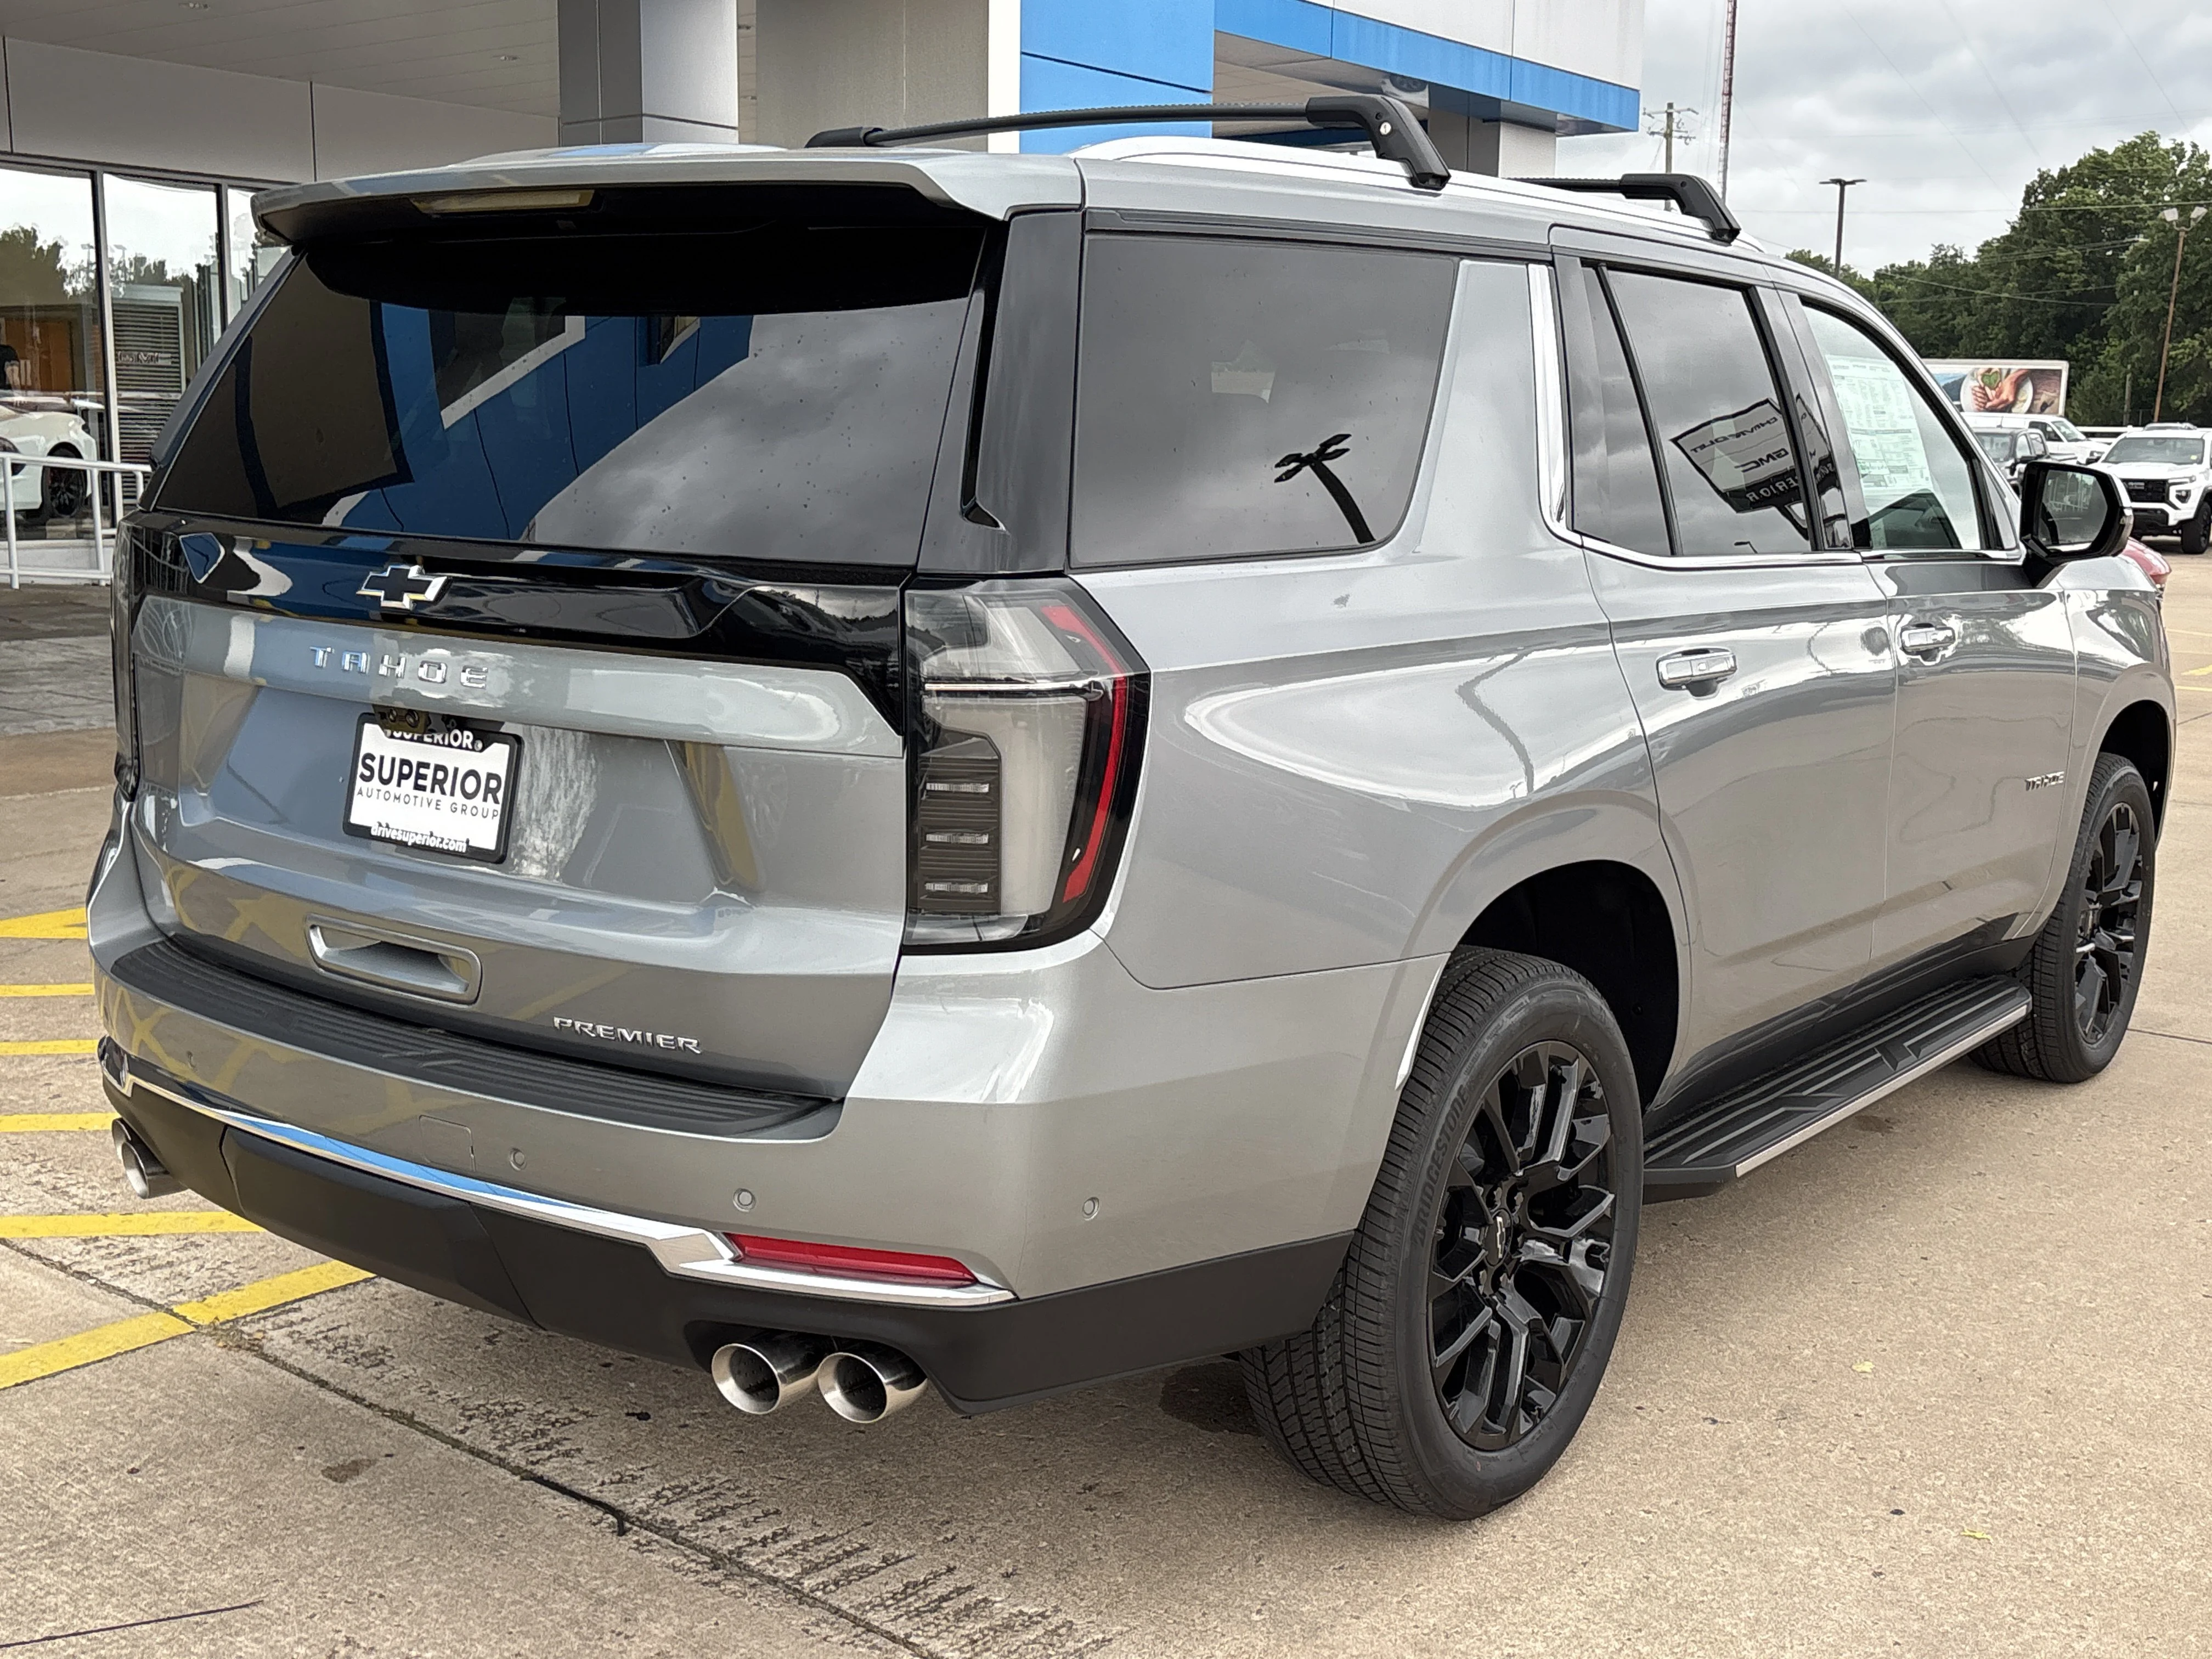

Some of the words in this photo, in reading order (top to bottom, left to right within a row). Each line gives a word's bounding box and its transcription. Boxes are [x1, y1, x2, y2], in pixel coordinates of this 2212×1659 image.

[309, 646, 488, 689] TAHOE
[359, 752, 502, 804] SUPERIOR
[357, 786, 442, 811] AUTOMOTIVE
[450, 802, 499, 820] GROUP
[370, 822, 467, 853] drivesuperior.com
[553, 1015, 702, 1055] PREMIER
[1411, 1084, 1468, 1248] BRIDGESTONE
